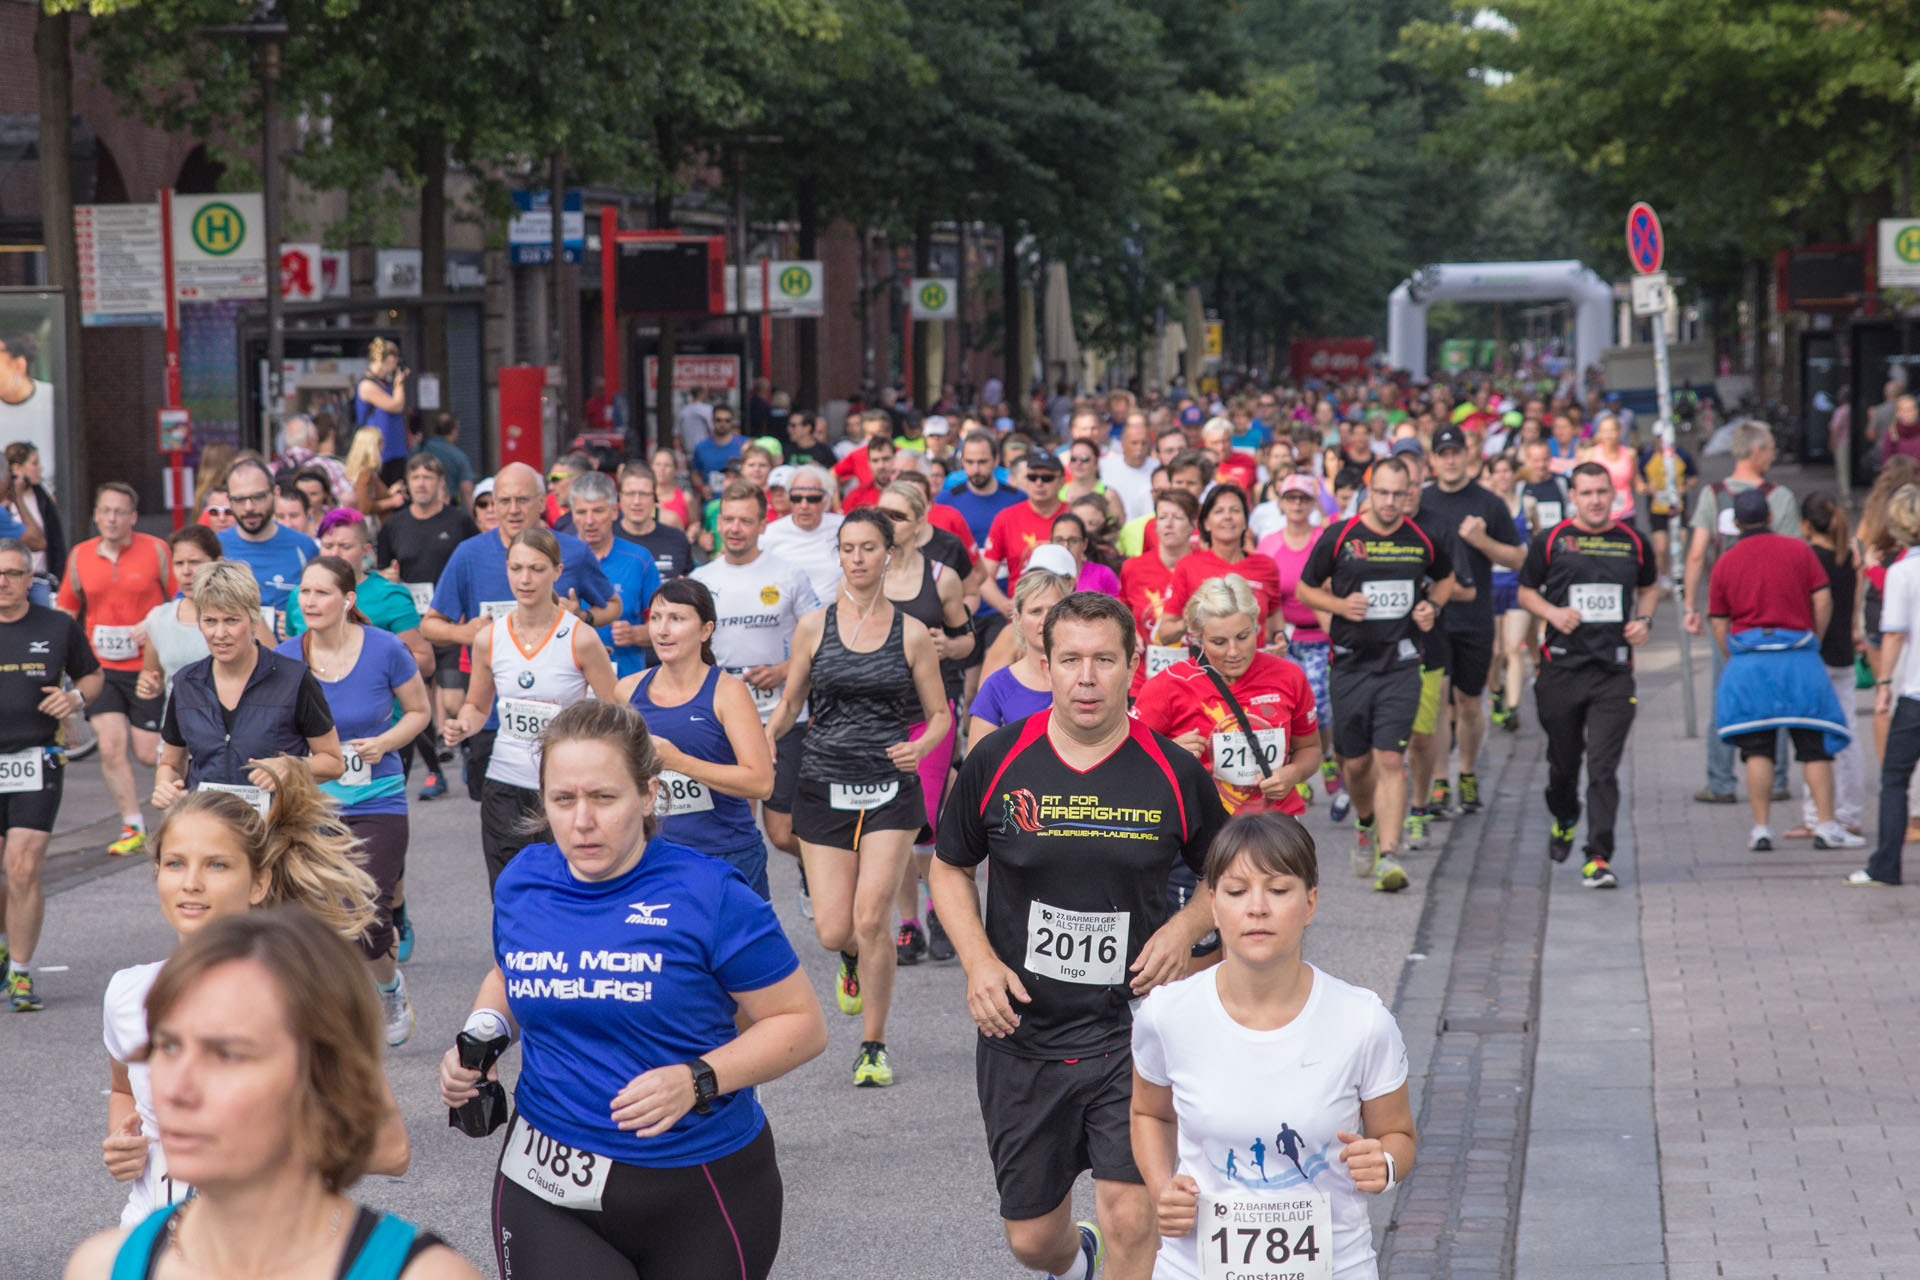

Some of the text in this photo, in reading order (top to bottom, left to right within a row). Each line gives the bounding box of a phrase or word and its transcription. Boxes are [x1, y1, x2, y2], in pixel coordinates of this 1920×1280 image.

[206, 214, 232, 243] H
[1369, 592, 1409, 608] 2023
[1577, 595, 1616, 610] 1603
[715, 614, 780, 627] TRIONIK
[98, 636, 133, 649] 1321
[1221, 743, 1277, 768] 210
[1041, 795, 1099, 806] FIT FOR
[1039, 806, 1162, 823] FIREFIGHTING
[1056, 912, 1066, 921] 27.
[1066, 914, 1101, 924] BARMER
[1101, 916, 1117, 924] GEK
[1055, 920, 1116, 933] ALSTERLAUF
[1034, 927, 1118, 964] 2016
[505, 950, 663, 974] MOIN, MOIN
[1060, 965, 1086, 979] Ingo
[508, 977, 653, 1002] HAMBURG!
[523, 1124, 597, 1188] 1083
[526, 1167, 566, 1199] Claudia
[1233, 1202, 1246, 1211] 27.
[1246, 1202, 1291, 1211] BARMER
[1291, 1200, 1313, 1209] GEK
[1233, 1209, 1314, 1224] ALSTERLAUF
[1211, 1224, 1321, 1265] 1784
[1225, 1271, 1306, 1280] Constanze
